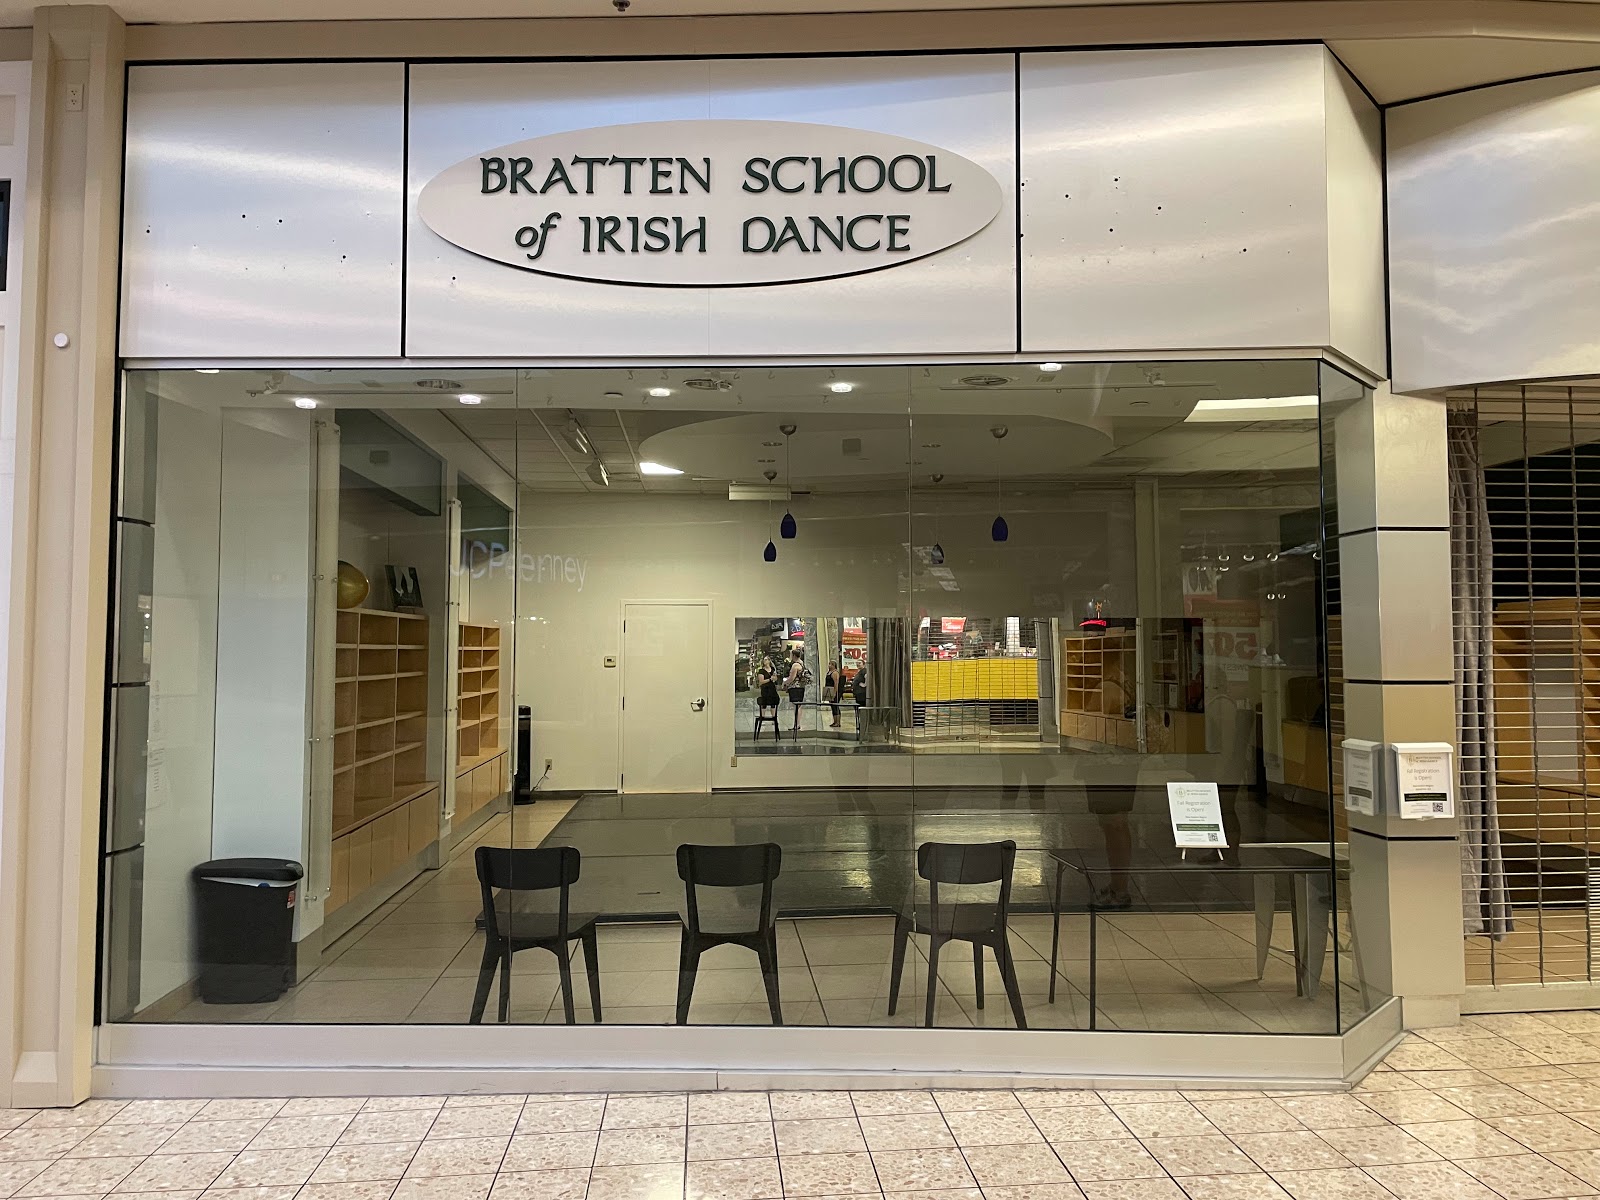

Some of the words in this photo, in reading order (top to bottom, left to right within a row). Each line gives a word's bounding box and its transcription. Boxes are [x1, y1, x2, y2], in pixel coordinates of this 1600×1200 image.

[480, 155, 711, 195] BRATTEN
[742, 154, 952, 194] SCHOOL
[515, 212, 562, 260] of
[579, 215, 707, 253] IRISH
[743, 214, 911, 253] DANCE
